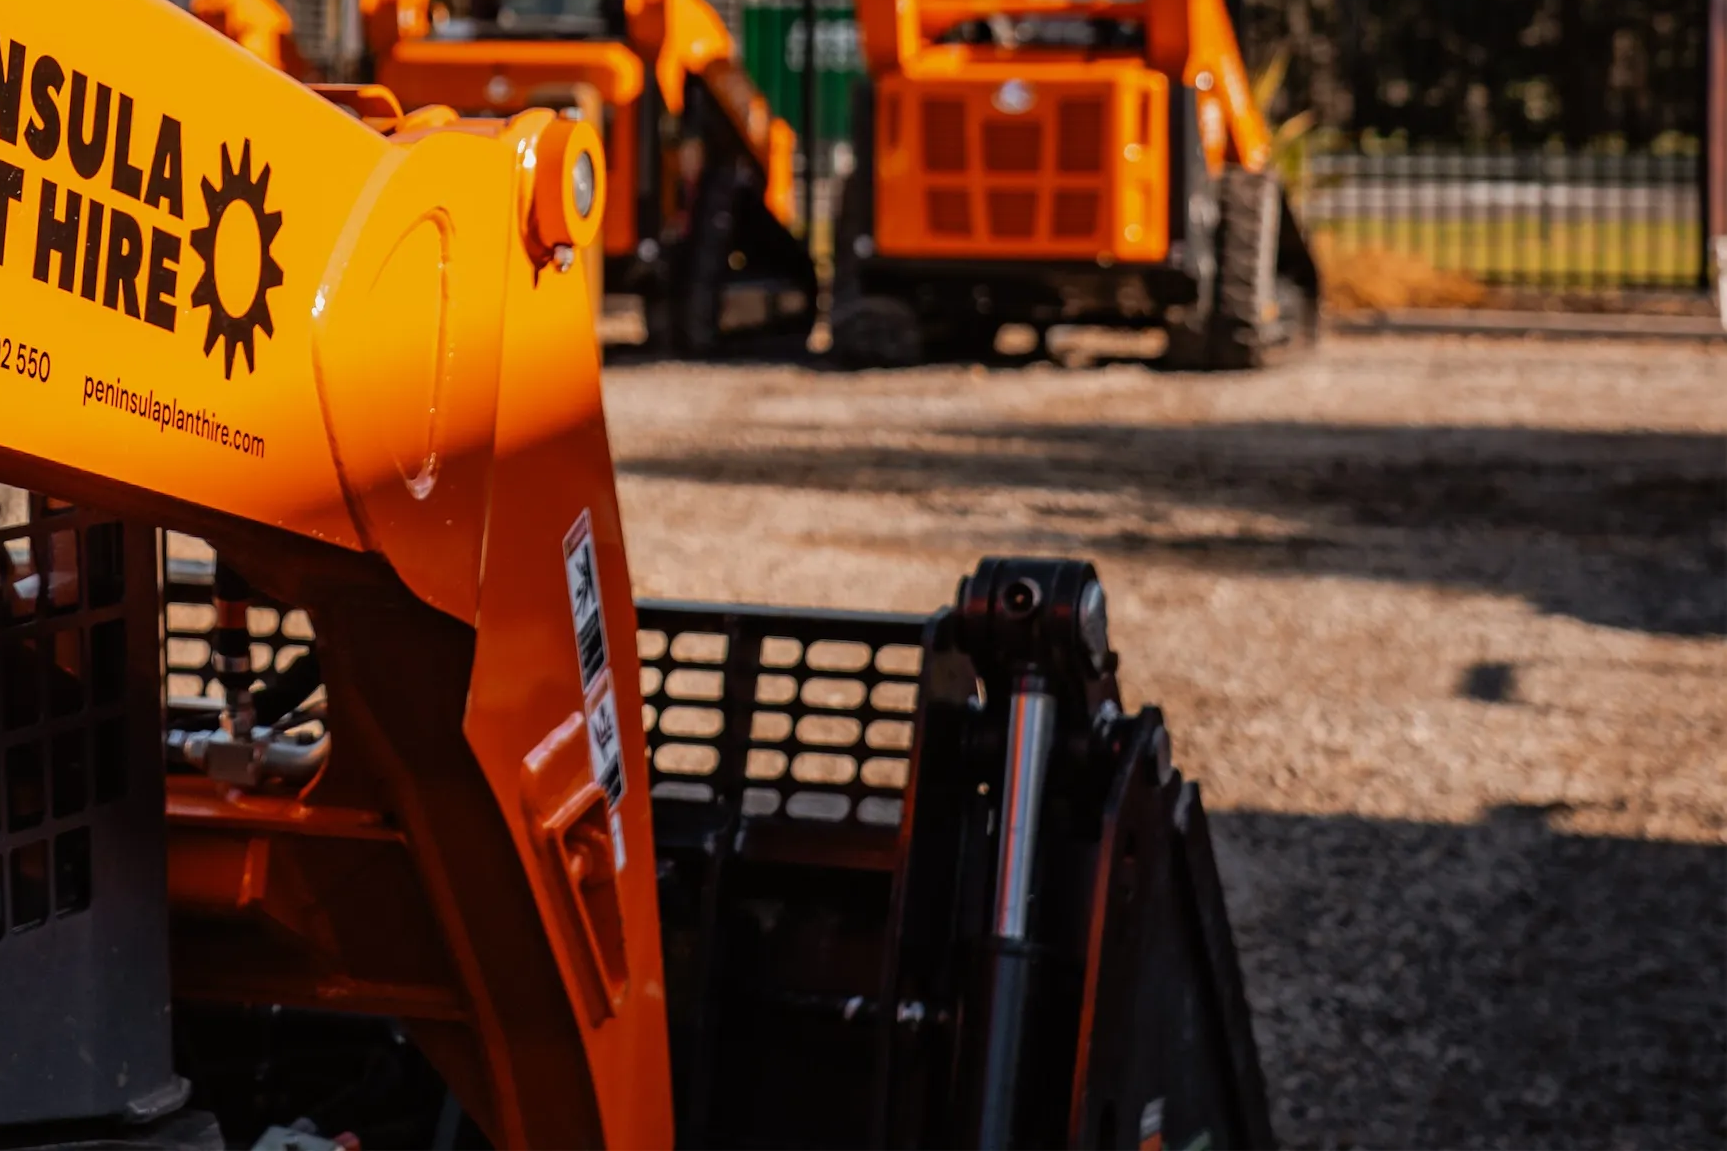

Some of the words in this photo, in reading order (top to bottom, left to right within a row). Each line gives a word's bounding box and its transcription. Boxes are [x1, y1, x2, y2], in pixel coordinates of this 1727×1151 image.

[32, 177, 182, 333] HIRE
[16, 343, 51, 383] 550
[82, 374, 266, 459] peninsulaplanthire.com
